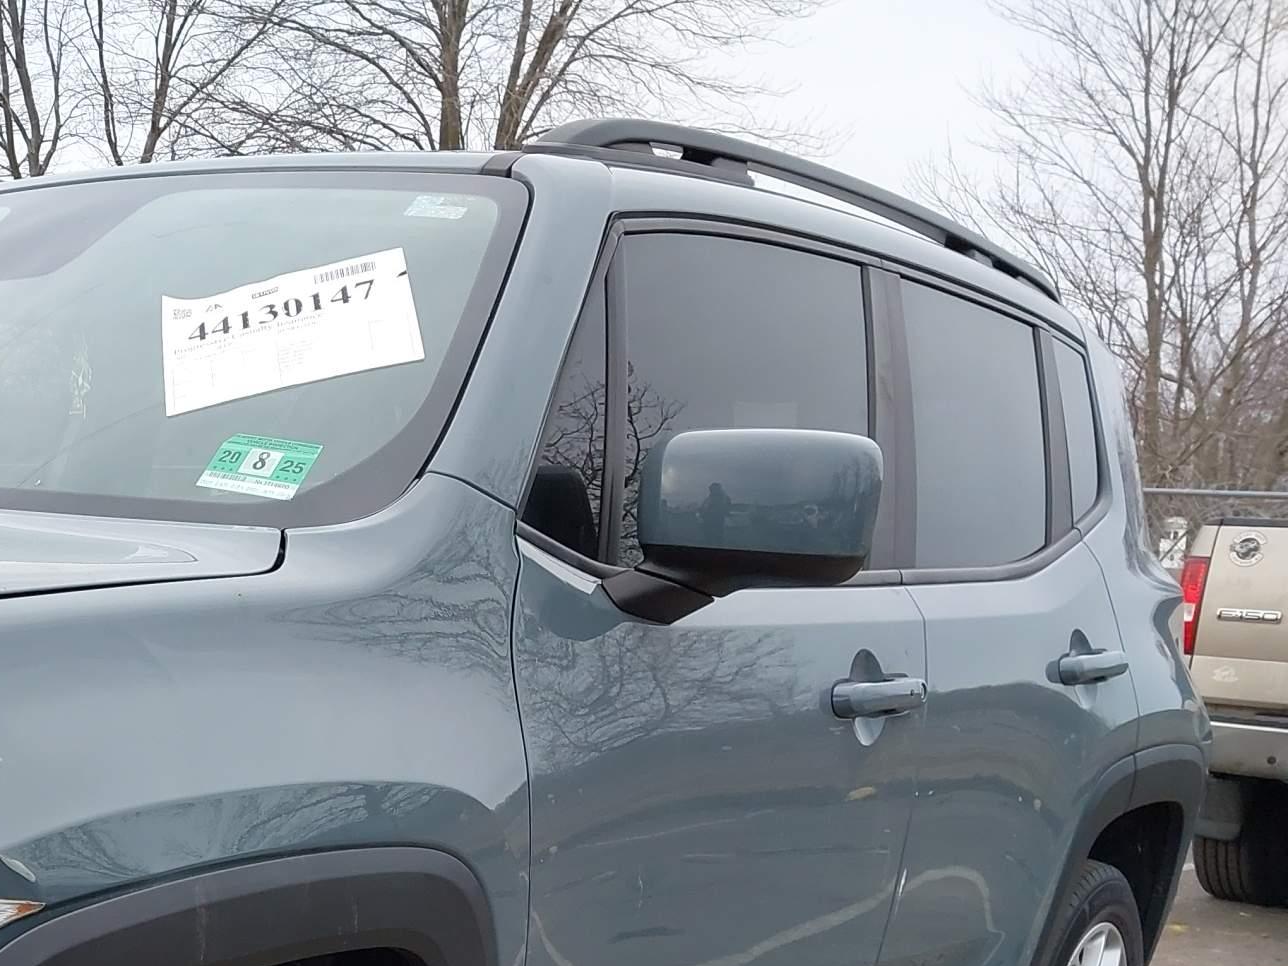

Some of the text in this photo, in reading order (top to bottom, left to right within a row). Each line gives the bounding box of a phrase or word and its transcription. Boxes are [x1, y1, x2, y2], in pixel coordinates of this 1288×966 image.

[187, 279, 375, 341] 44130147
[219, 450, 306, 475] 20 8 25
